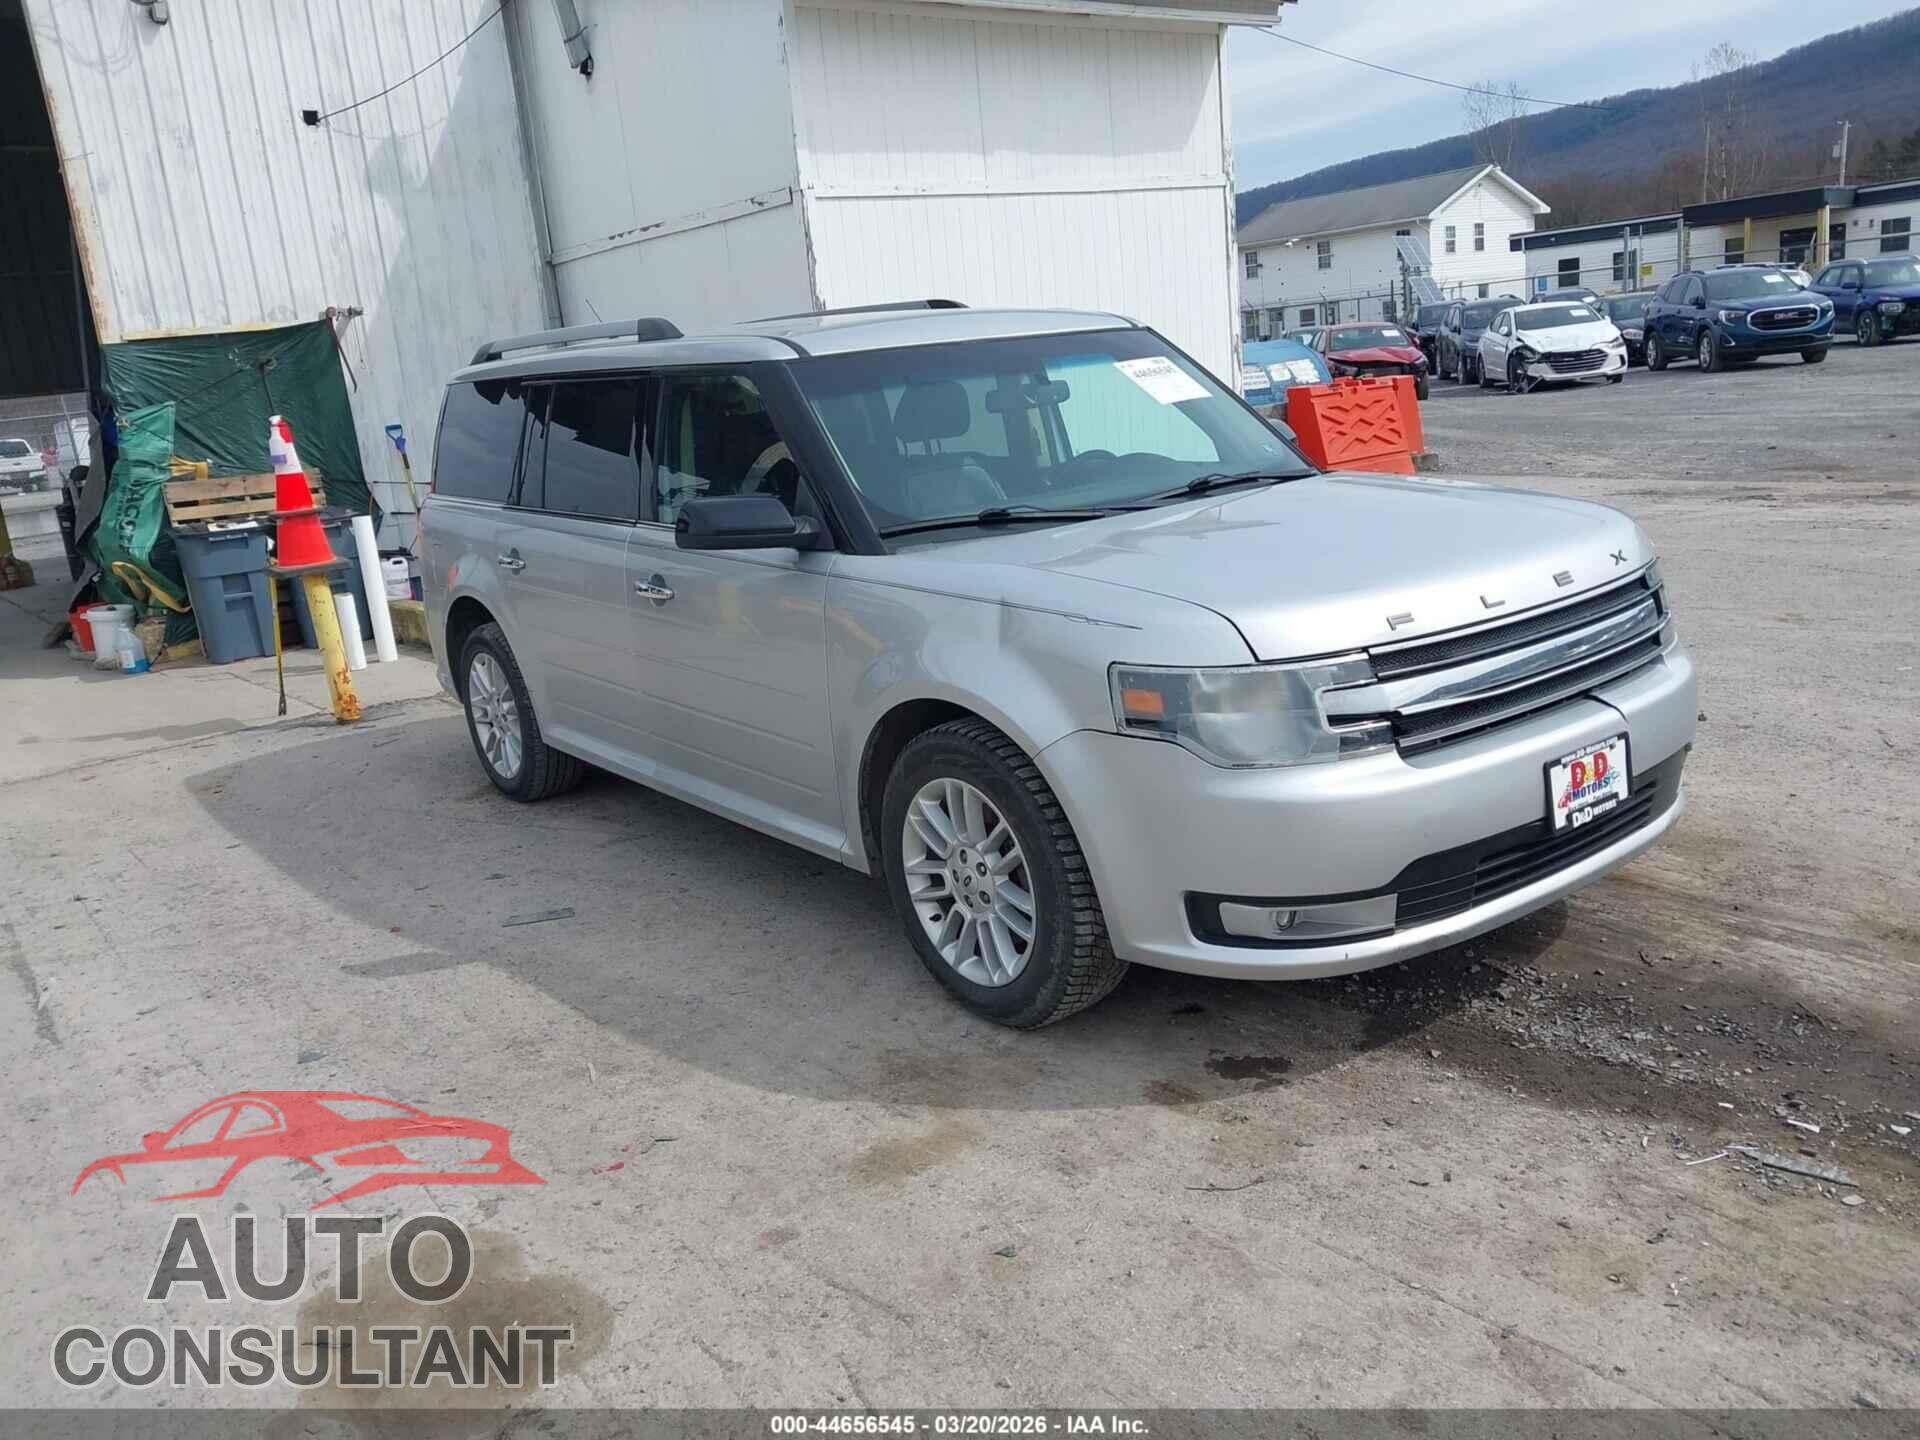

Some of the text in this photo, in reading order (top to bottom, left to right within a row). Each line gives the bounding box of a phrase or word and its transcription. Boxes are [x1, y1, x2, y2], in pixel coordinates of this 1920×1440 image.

[1773, 311, 1799, 320] GMC
[1385, 549, 1628, 632] FLEX
[1572, 777, 1610, 801] MOTORS
